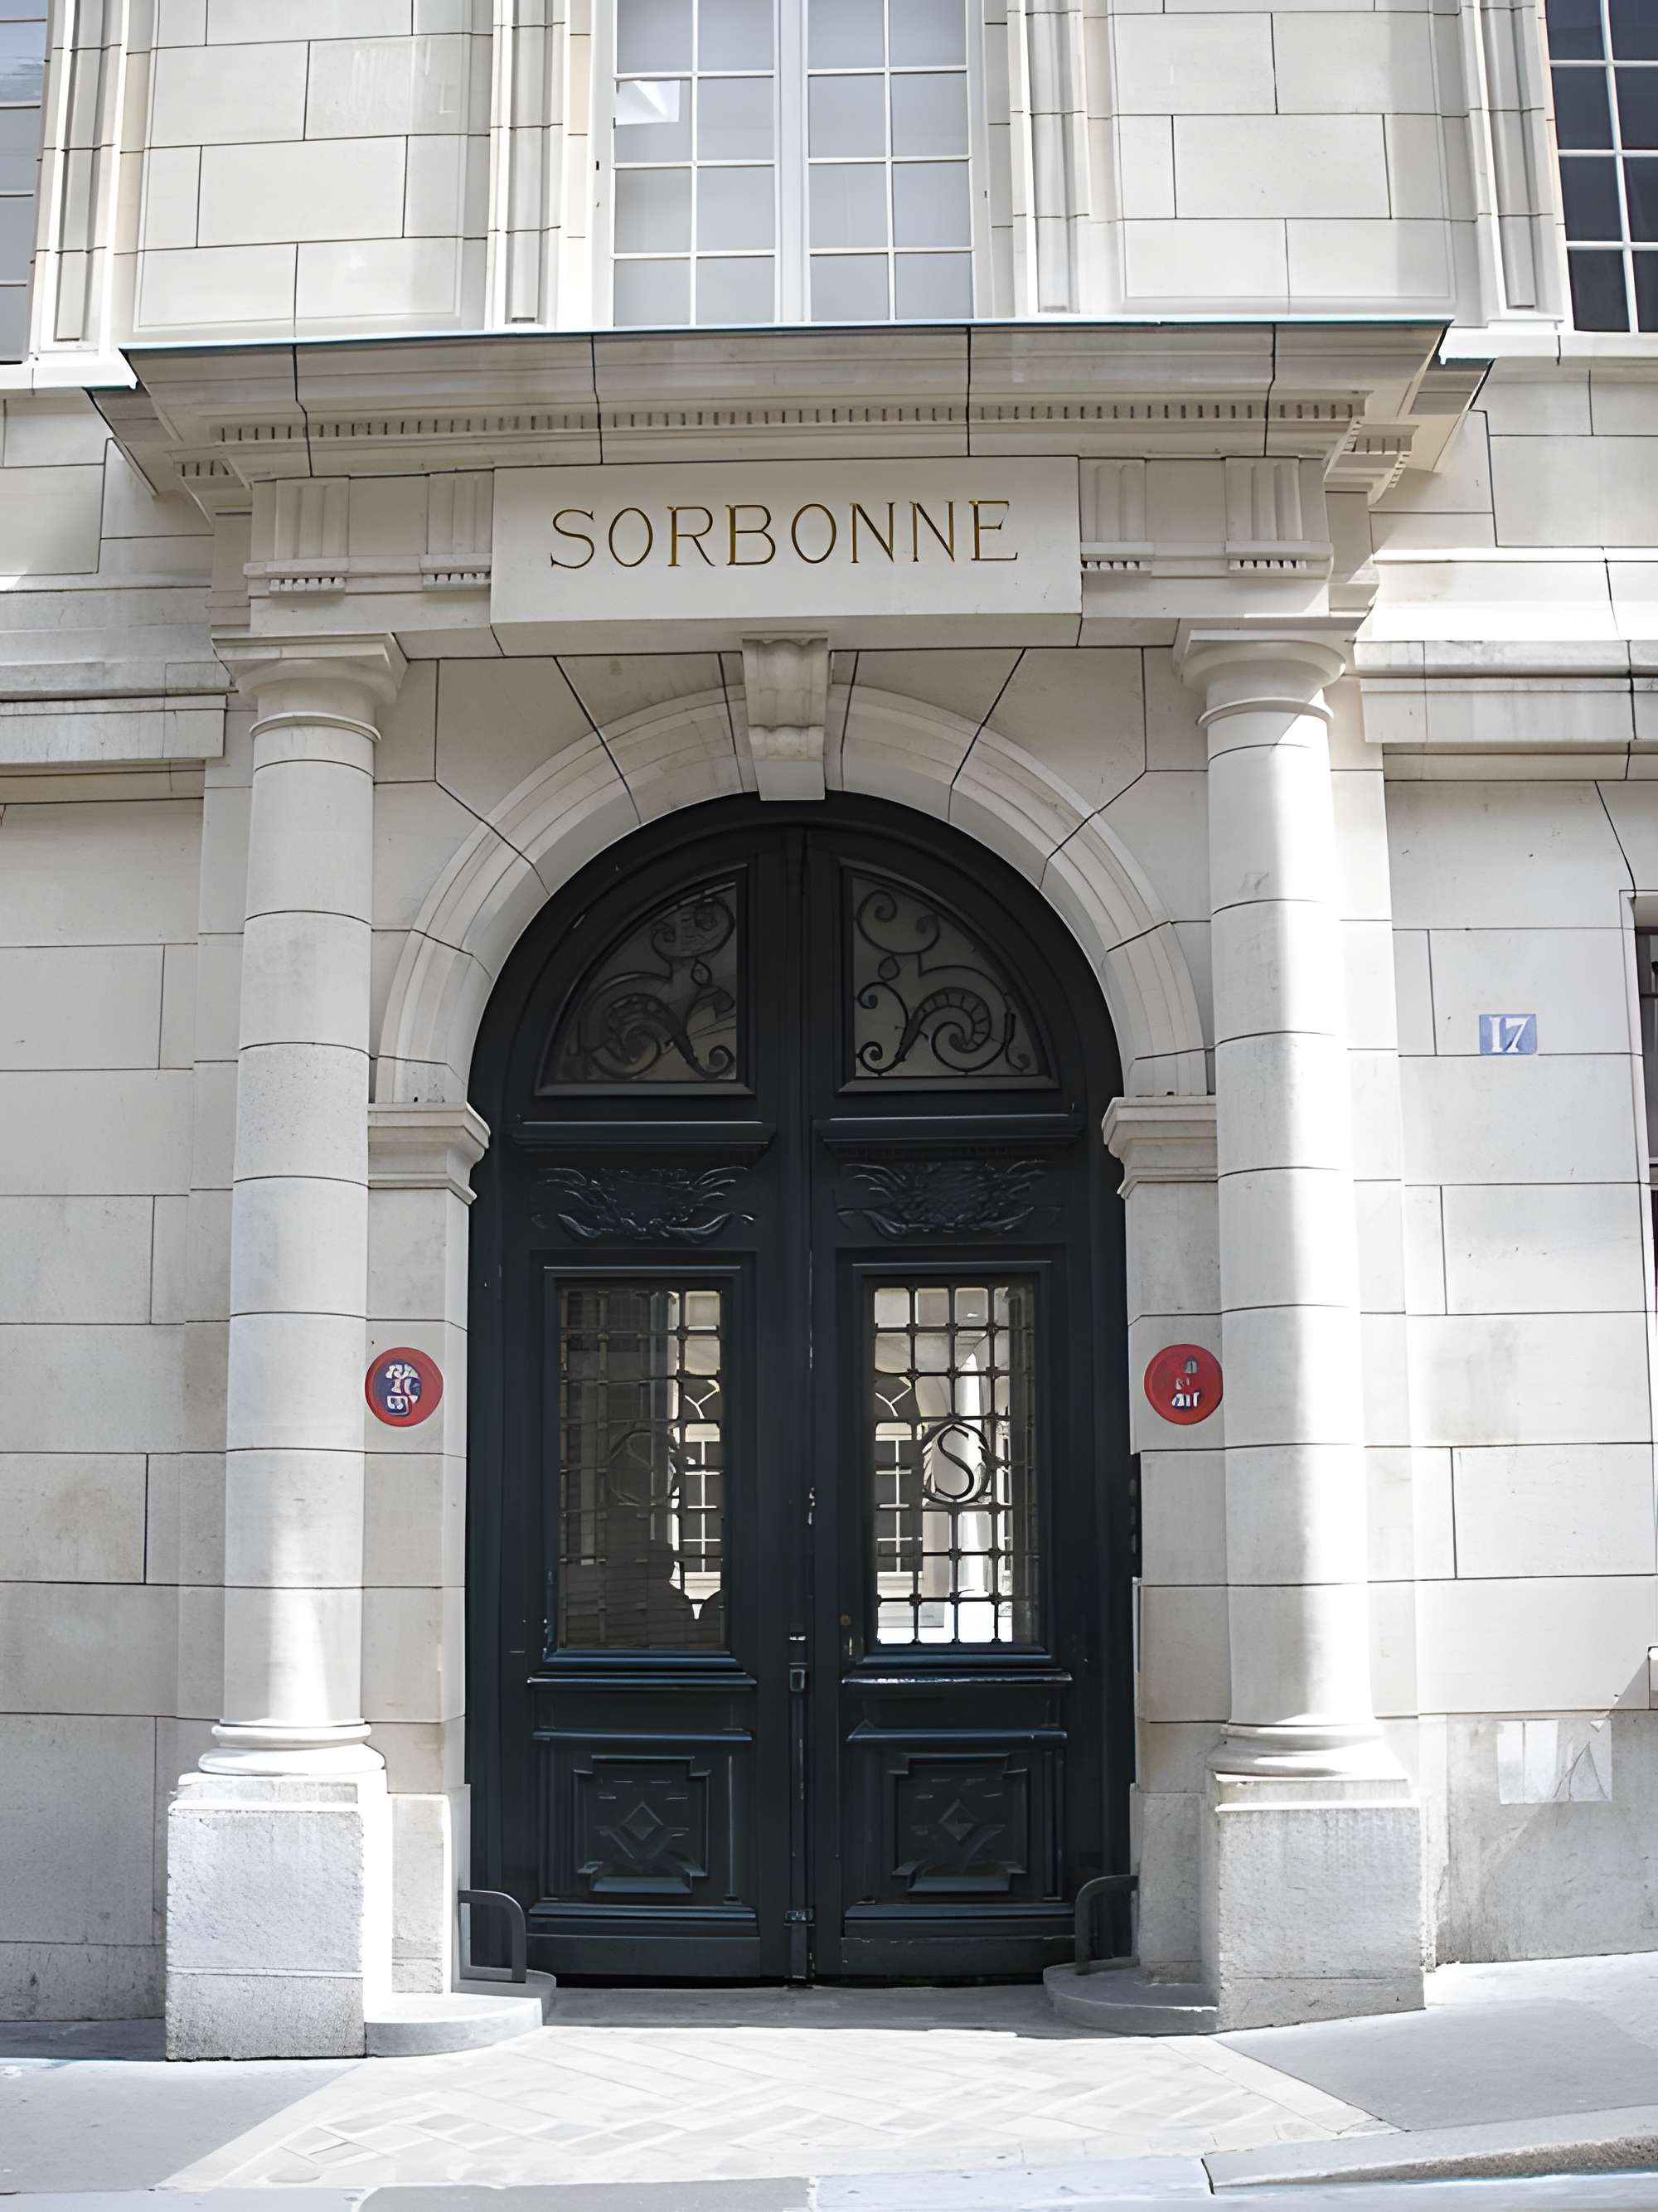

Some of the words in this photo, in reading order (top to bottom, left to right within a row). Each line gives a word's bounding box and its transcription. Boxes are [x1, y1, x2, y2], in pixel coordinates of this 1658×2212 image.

[550, 500, 1018, 569] SORBONNE
[1489, 1015, 1532, 1054] 17
[936, 1424, 975, 1500] S
